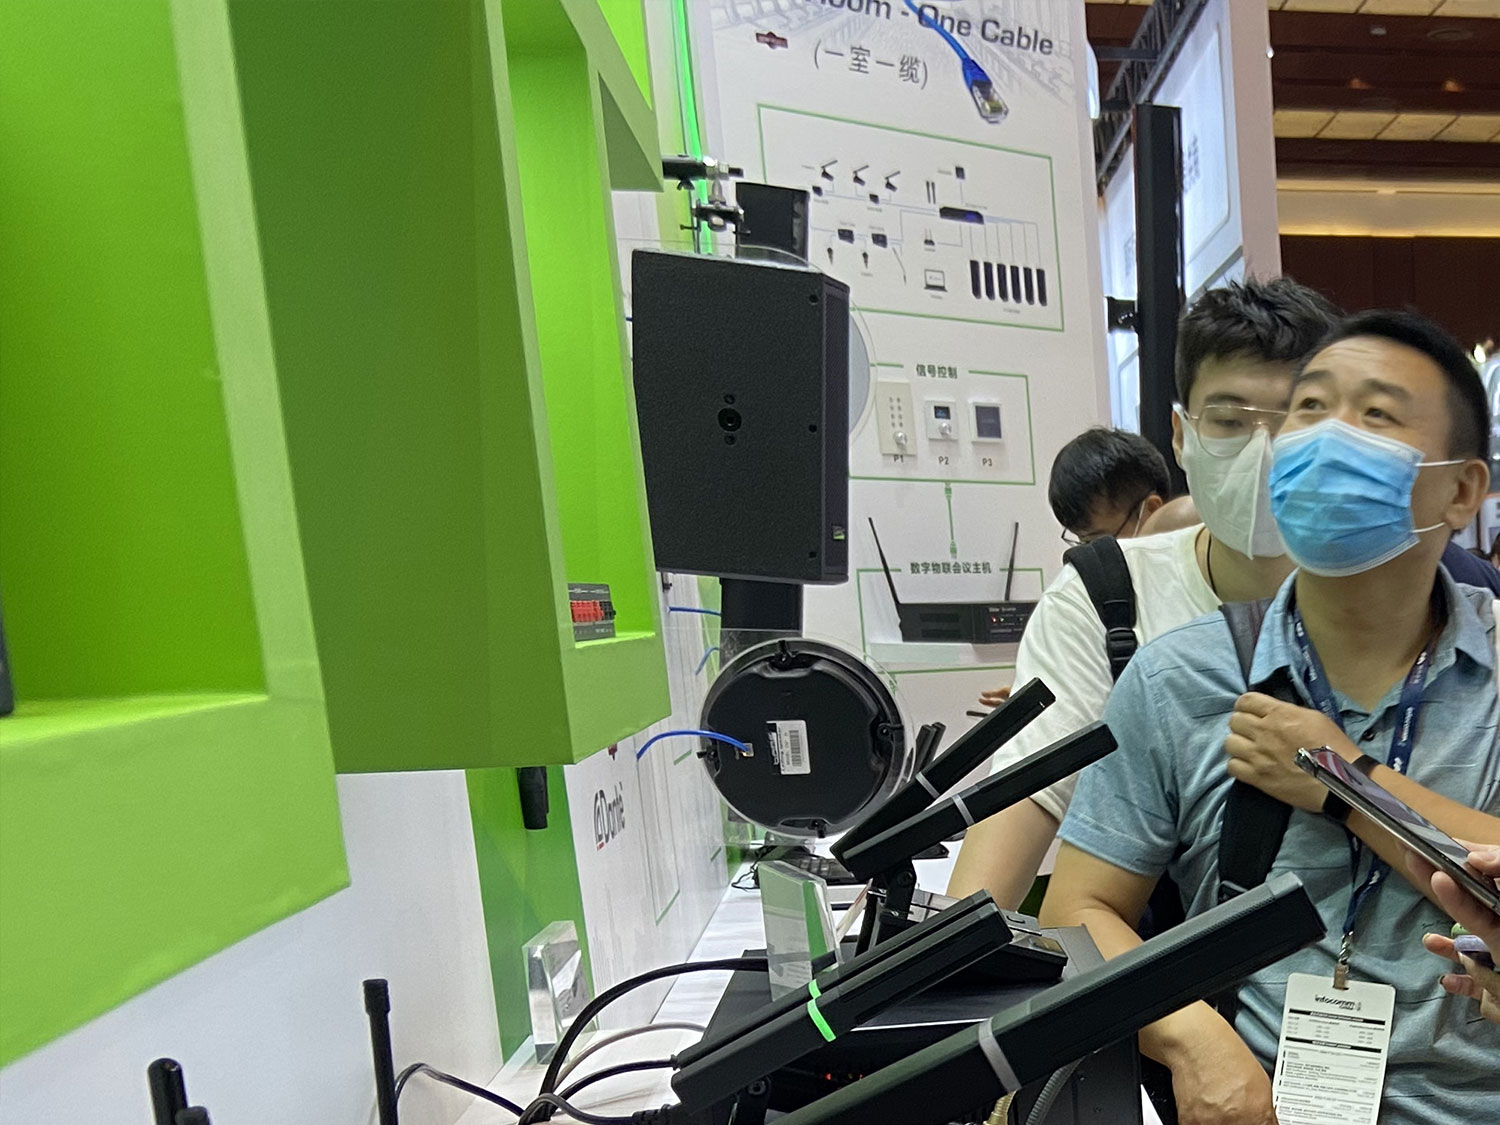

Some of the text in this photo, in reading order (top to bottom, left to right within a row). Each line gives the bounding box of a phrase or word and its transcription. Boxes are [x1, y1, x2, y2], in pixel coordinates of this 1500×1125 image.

[918, 4, 971, 37] One
[981, 18, 1053, 55] Cable
[916, 364, 958, 379] 信号控制
[939, 456, 949, 465] P2
[982, 458, 993, 467] P3
[910, 562, 992, 574] 数字物联会议主机
